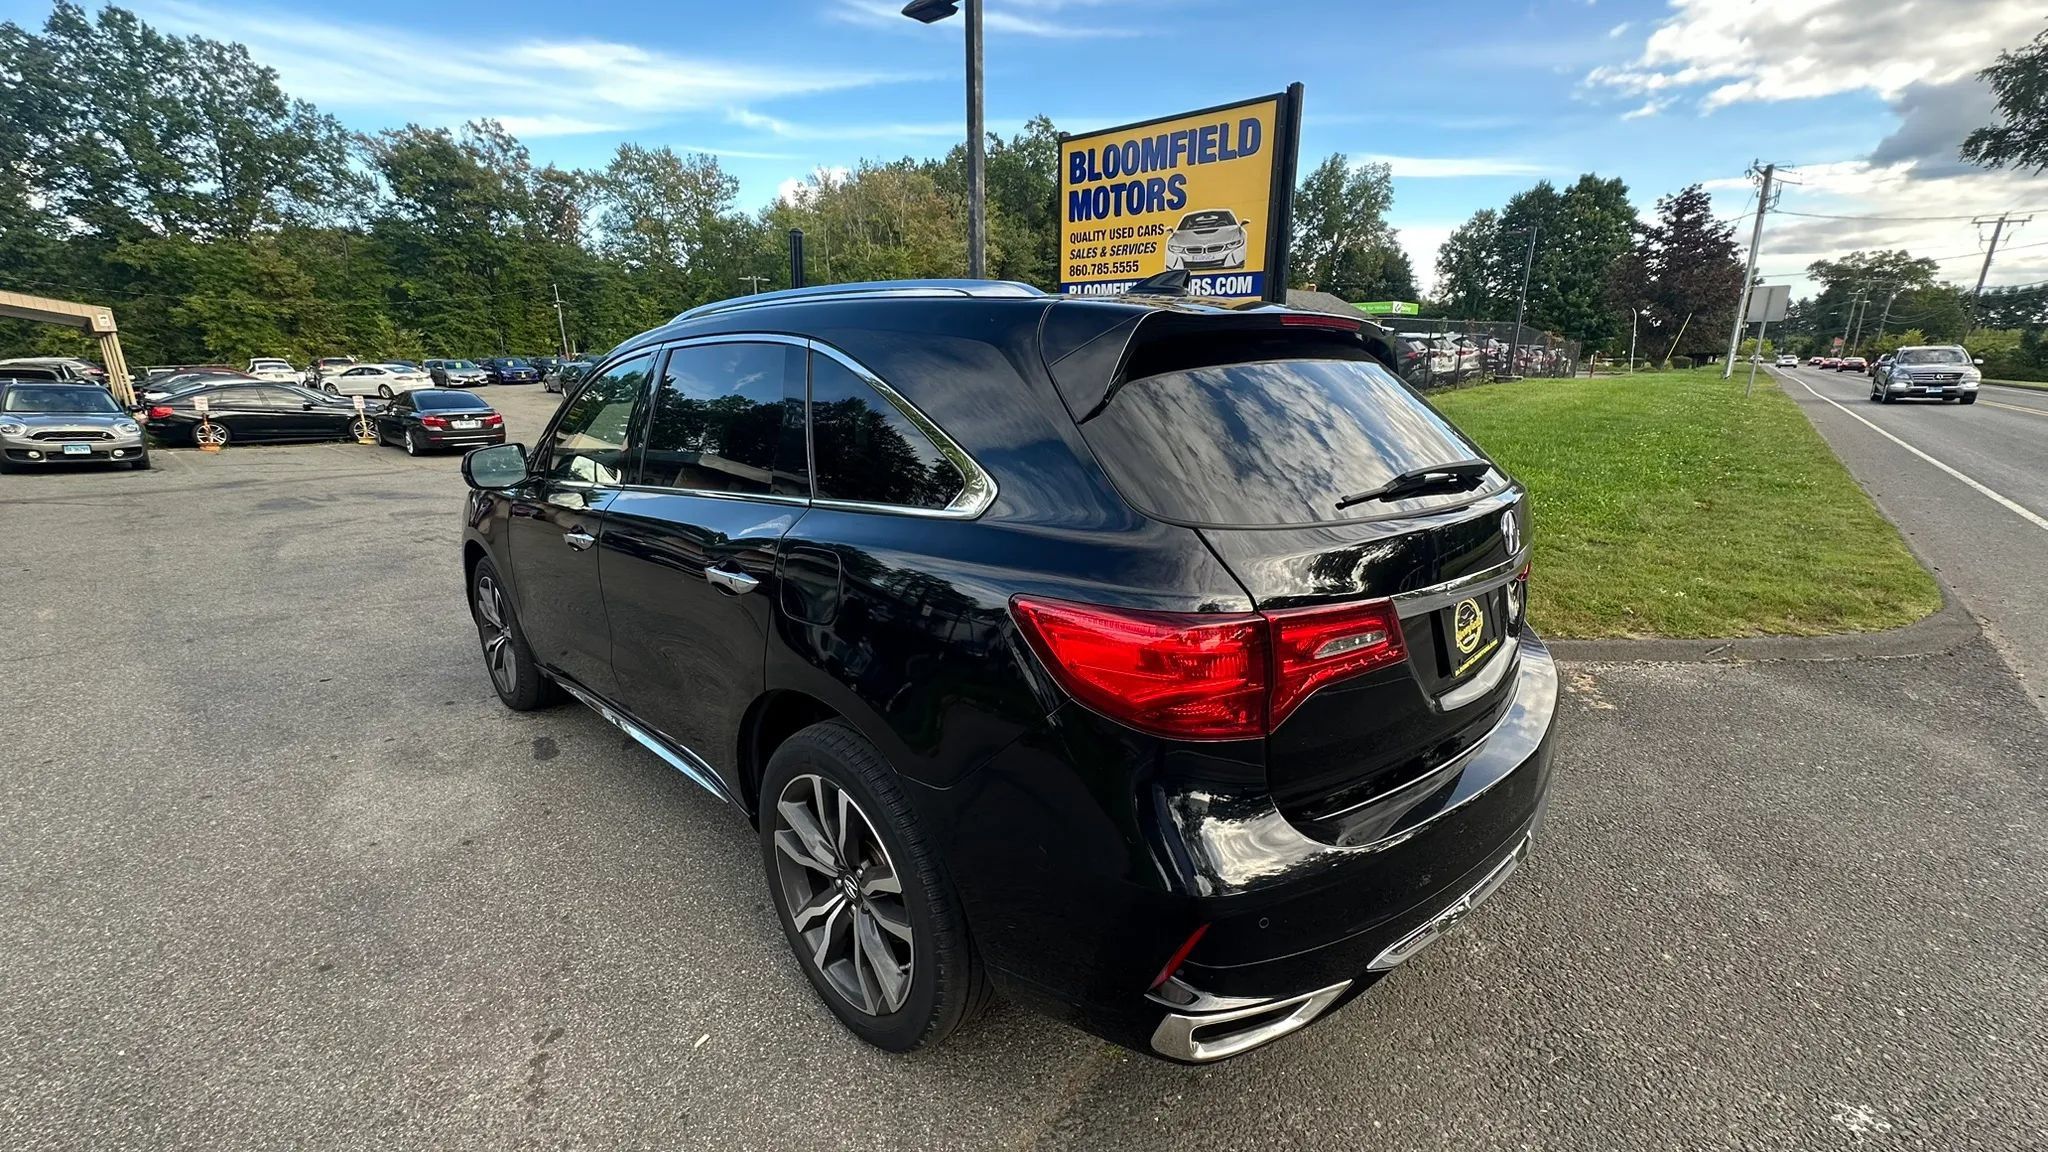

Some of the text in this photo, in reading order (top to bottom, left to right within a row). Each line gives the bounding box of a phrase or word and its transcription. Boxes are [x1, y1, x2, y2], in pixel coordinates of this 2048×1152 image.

[1069, 117, 1262, 185] BLOOMFIELD
[1069, 174, 1187, 222] MOTORS
[1070, 223, 1165, 244] QUALITY USED CARS
[1069, 241, 1157, 260] SALES & SERVICES
[1069, 260, 1139, 276] 860.785.5555
